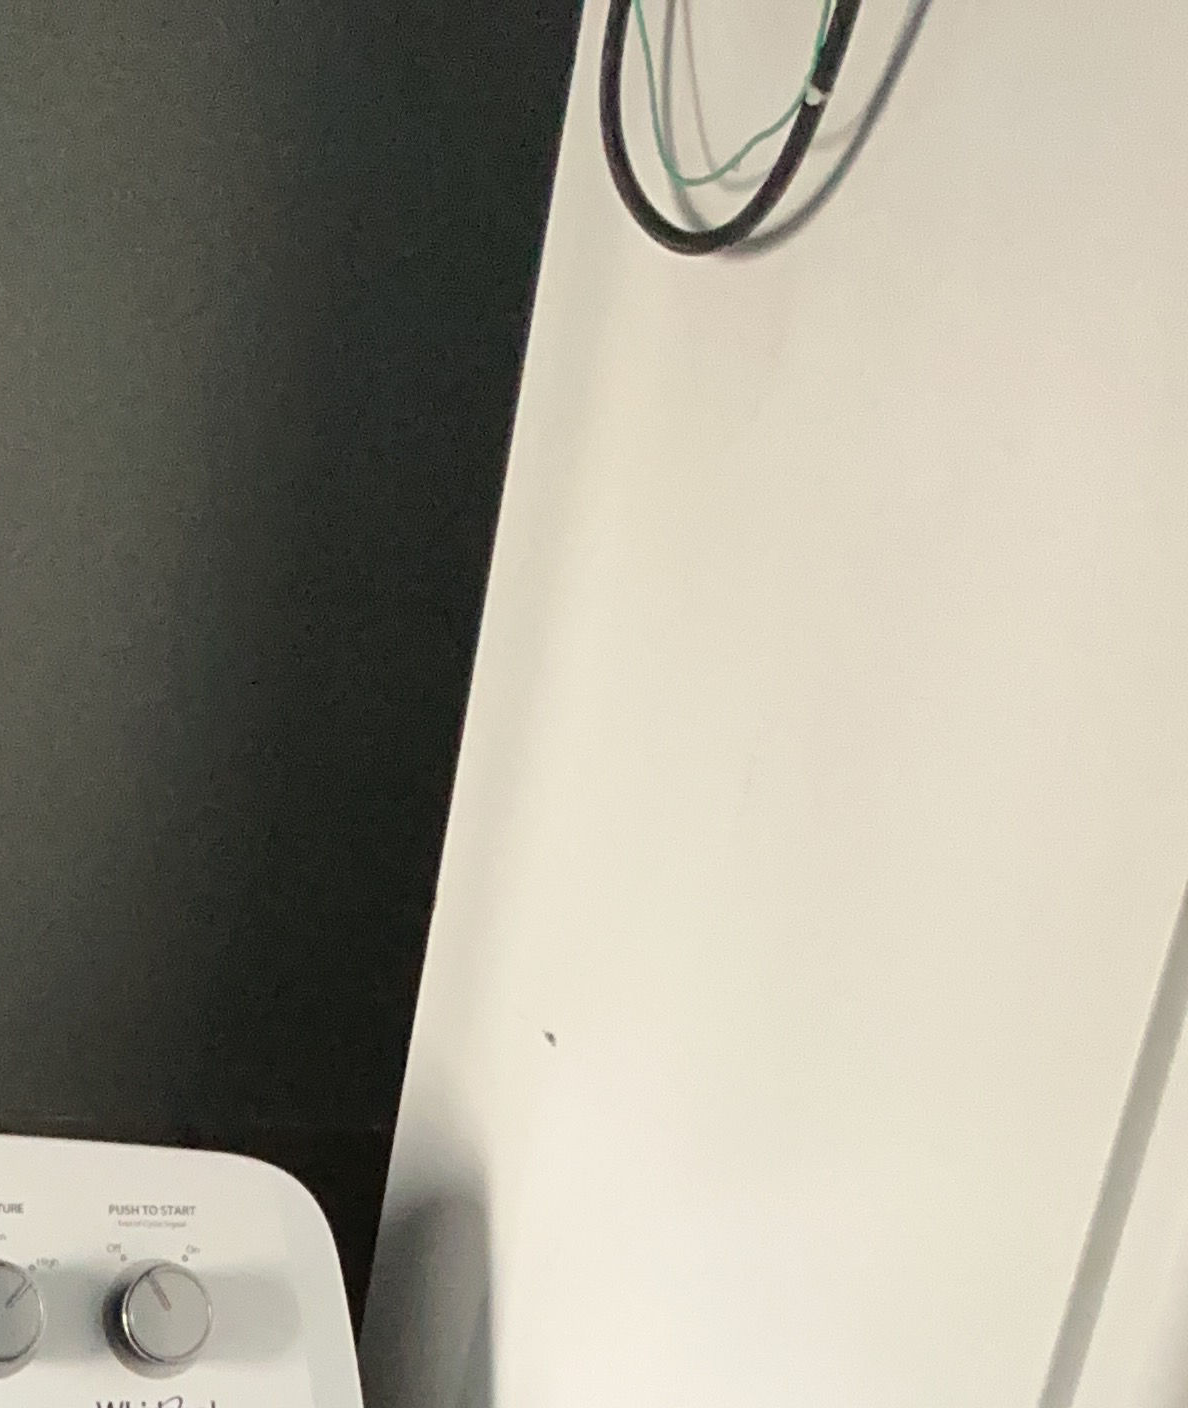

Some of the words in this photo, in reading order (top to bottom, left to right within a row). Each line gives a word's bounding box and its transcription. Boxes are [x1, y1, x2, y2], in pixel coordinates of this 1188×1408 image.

[108, 1204, 140, 1215] PUSH
[143, 1205, 158, 1215] TO
[160, 1205, 196, 1216] START
[36, 1258, 59, 1269] High
